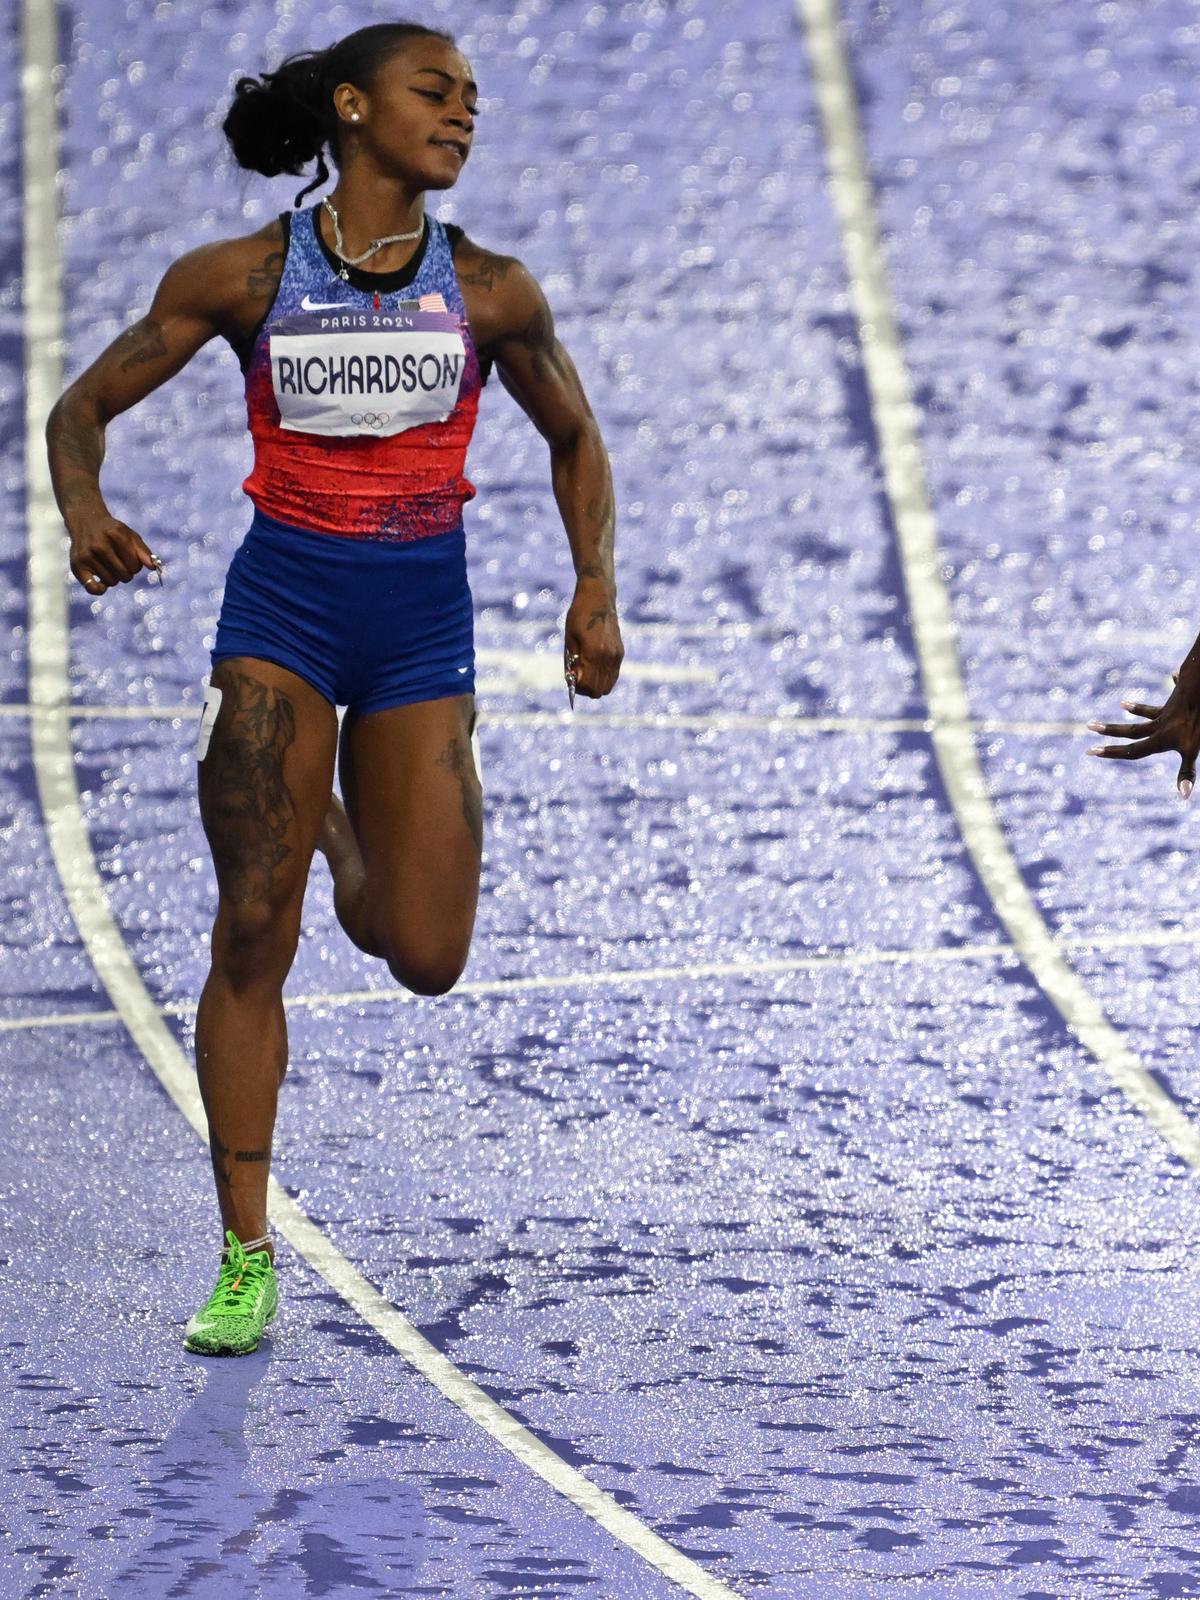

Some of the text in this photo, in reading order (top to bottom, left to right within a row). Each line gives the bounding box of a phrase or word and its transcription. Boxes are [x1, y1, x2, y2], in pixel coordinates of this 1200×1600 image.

[321, 315, 414, 328] PARIS 2024
[278, 353, 459, 395] RICHARDSON
